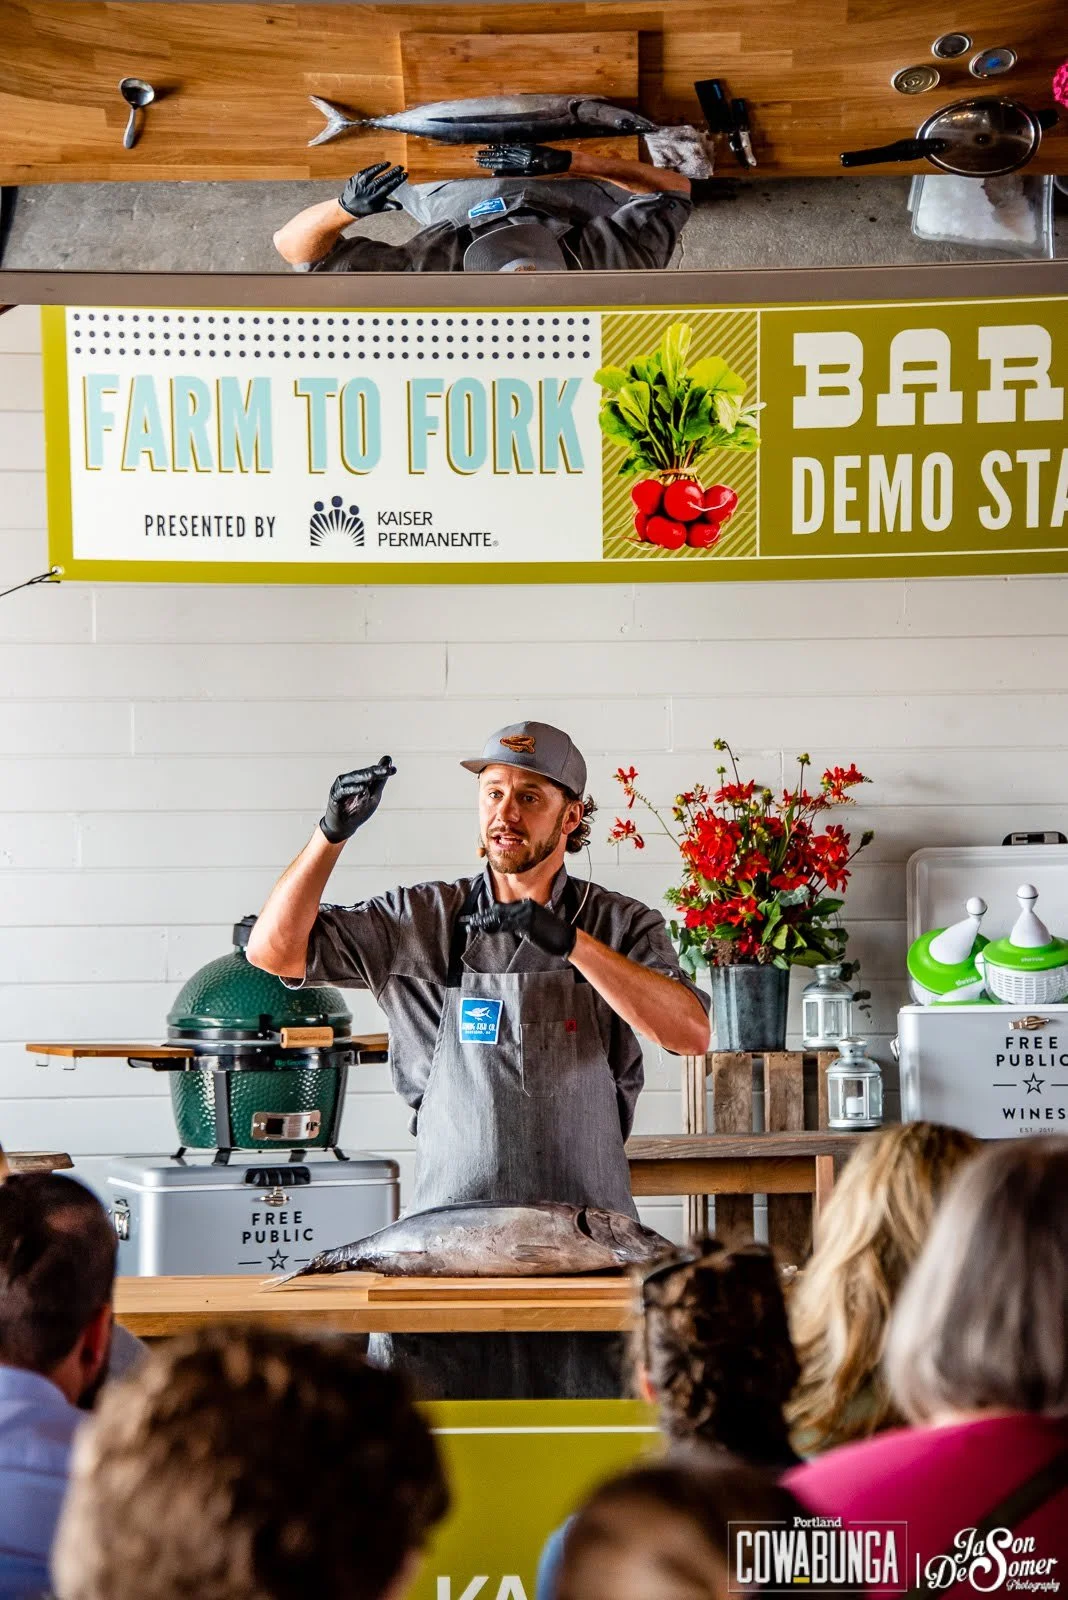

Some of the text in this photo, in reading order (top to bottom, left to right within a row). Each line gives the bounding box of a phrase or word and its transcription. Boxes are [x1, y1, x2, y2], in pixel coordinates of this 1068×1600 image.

[792, 324, 1064, 429] BAR
[83, 373, 585, 475] FARM TO FORK
[792, 451, 953, 534] DEMO
[145, 514, 276, 538] PRESENTED BY
[377, 511, 433, 526] KAISER
[1005, 1036, 1058, 1049] FREE
[996, 1053, 1068, 1067] PUBLIC
[1002, 1107, 1066, 1120] WINES
[252, 1211, 303, 1226] FREE
[242, 1228, 314, 1245] PUBLIC
